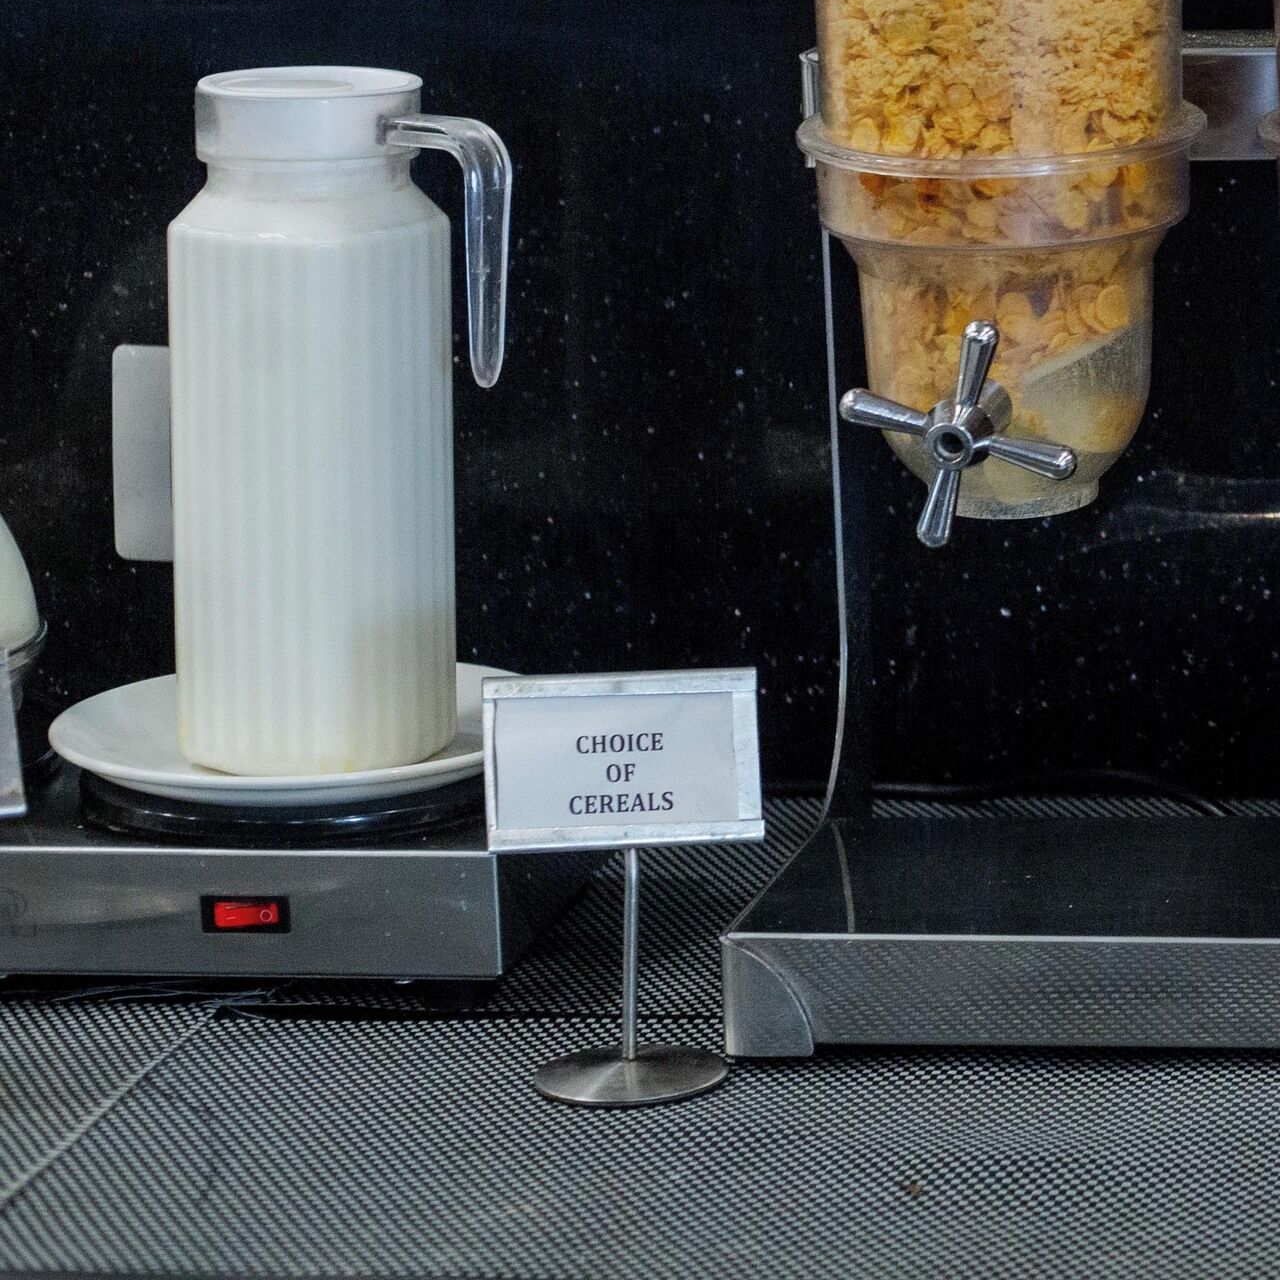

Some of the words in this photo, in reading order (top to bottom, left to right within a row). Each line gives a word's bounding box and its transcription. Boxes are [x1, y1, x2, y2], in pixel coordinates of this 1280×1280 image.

[576, 732, 664, 754] CHOICE
[606, 763, 636, 783] OF
[569, 791, 674, 815] CEREALS
